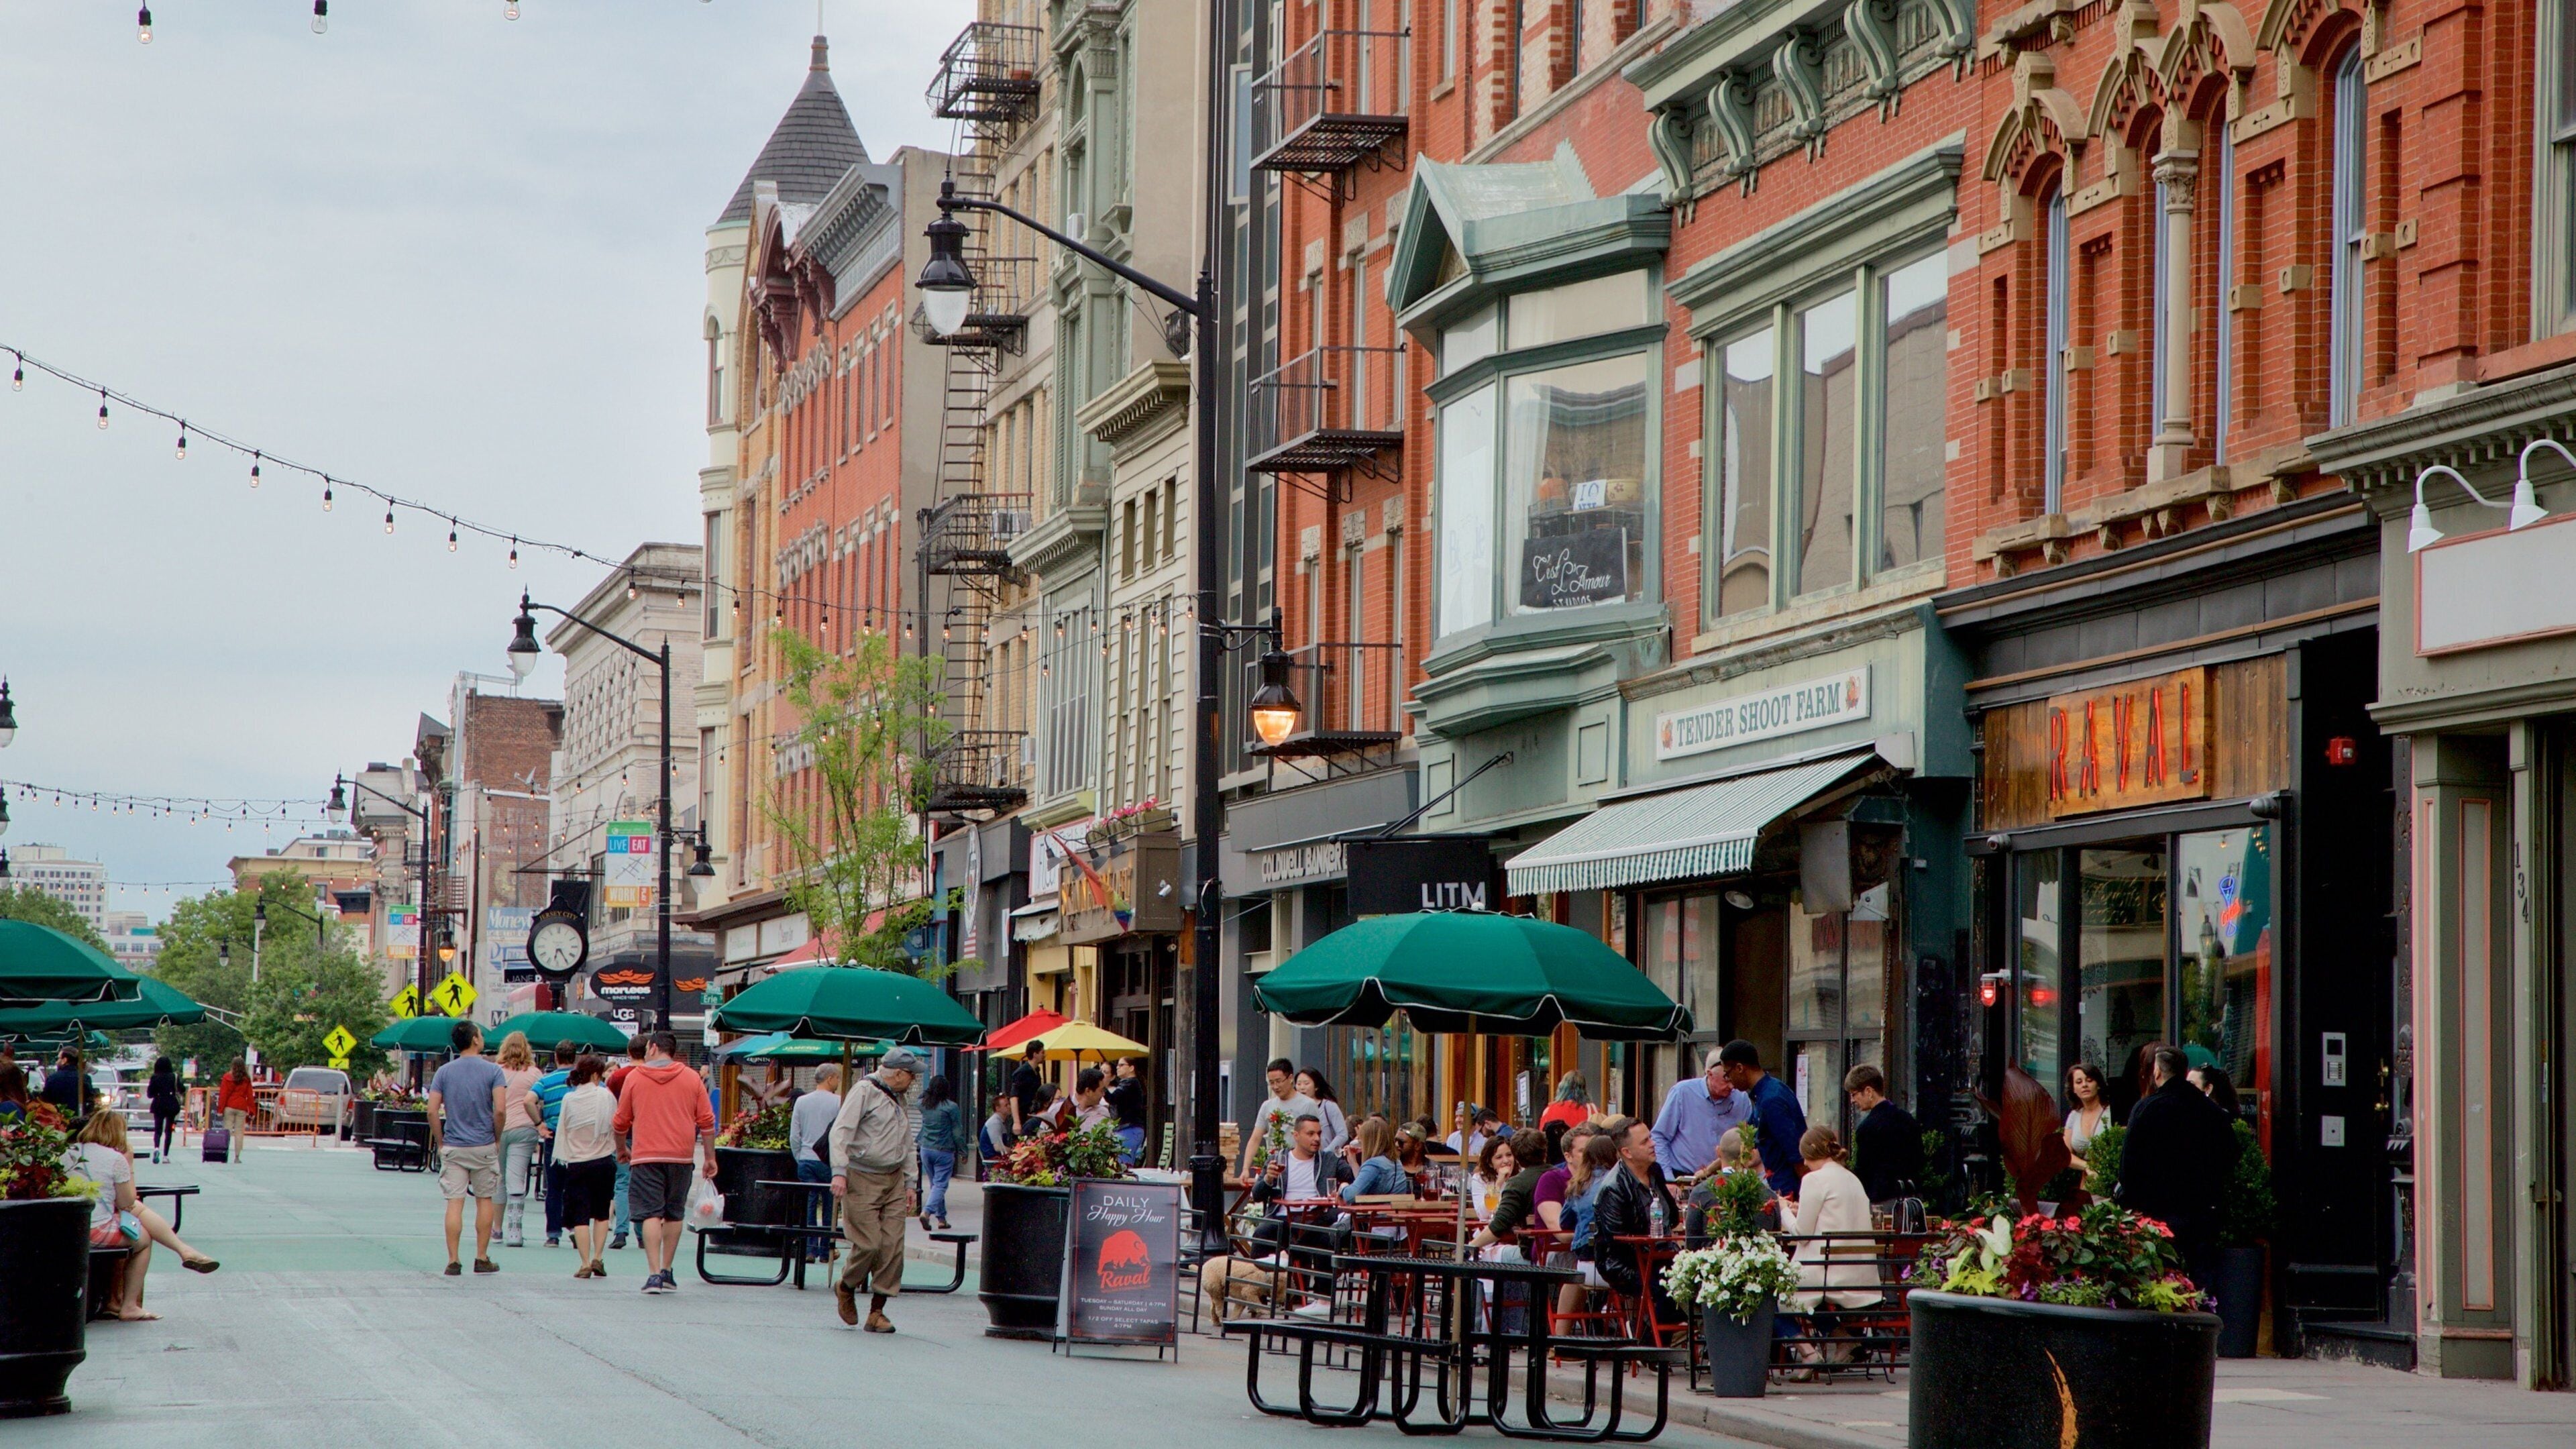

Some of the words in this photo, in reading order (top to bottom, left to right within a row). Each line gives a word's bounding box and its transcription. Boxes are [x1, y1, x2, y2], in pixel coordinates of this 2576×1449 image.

[1677, 708, 1734, 747] TENDER
[1739, 694, 1790, 735] SHOOT
[1796, 682, 1841, 722] FARM
[2050, 682, 2198, 801] RAVAL
[609, 839, 627, 851] LIVE
[632, 839, 647, 851] EAT
[609, 888, 636, 902] WORK
[1421, 881, 1487, 909] LITM
[404, 915, 414, 924] EAT
[539, 911, 562, 920] JERSEY
[563, 912, 578, 920] CITY
[507, 975, 534, 983] JANE
[704, 995, 718, 1004] Erie
[613, 1008, 635, 1021] UGG
[1104, 1195, 1150, 1208] DAILY
[1087, 1205, 1128, 1227] Happy
[1131, 1208, 1165, 1224] Hour
[1100, 1265, 1151, 1289] Raval
